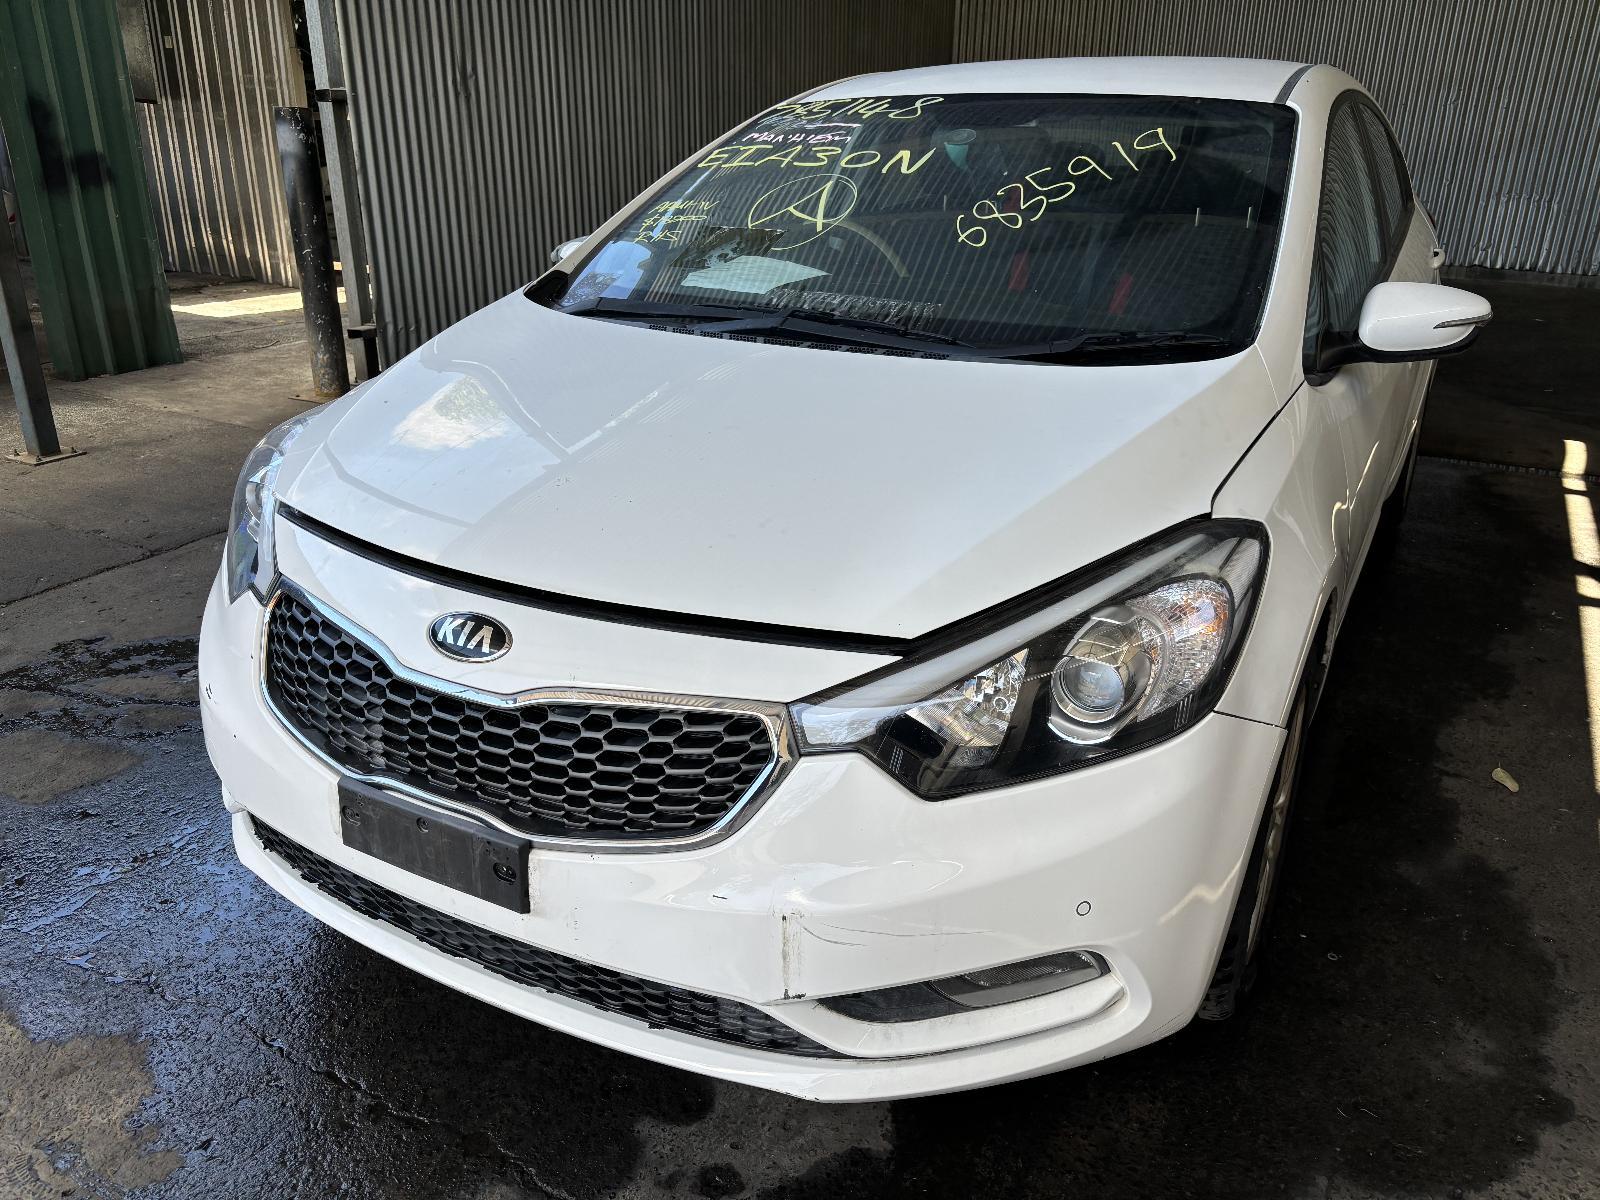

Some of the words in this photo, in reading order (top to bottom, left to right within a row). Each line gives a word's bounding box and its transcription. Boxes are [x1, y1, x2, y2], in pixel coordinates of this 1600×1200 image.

[750, 178, 842, 236] A
[956, 128, 1176, 247] 6835919
[436, 617, 494, 654] KIA
